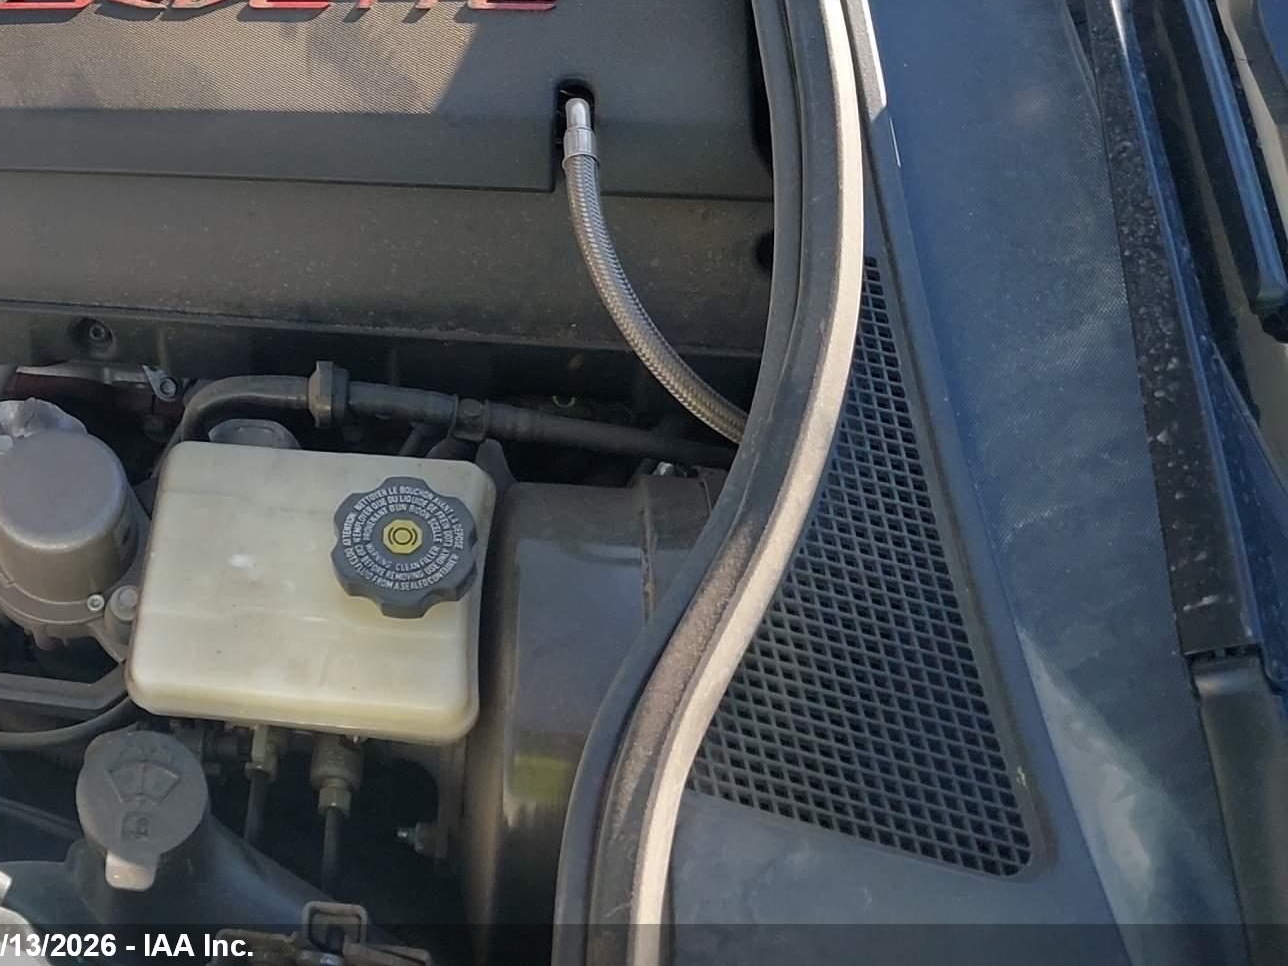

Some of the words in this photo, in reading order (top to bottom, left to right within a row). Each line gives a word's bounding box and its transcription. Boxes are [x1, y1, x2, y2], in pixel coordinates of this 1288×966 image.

[342, 512, 356, 546] ATTENTION
[354, 489, 387, 511] NETTOYER
[388, 486, 398, 495] LE
[399, 485, 434, 500] BOUCHON
[432, 497, 454, 515] AVANT
[371, 497, 387, 510] QUE
[387, 495, 398, 503] DU
[399, 494, 428, 507] LIQUIDE
[354, 563, 374, 580] FLUID
[372, 575, 393, 589] FROM
[400, 579, 428, 591] SEALED
[428, 553, 459, 584] CONTAINER
[360, 555, 386, 576] BEFORE
[385, 570, 424, 580] REMOVING
[424, 562, 440, 575] USE
[436, 548, 450, 565] ONLY
[395, 561, 420, 571] CLEAN
[419, 545, 440, 566] FILLER
